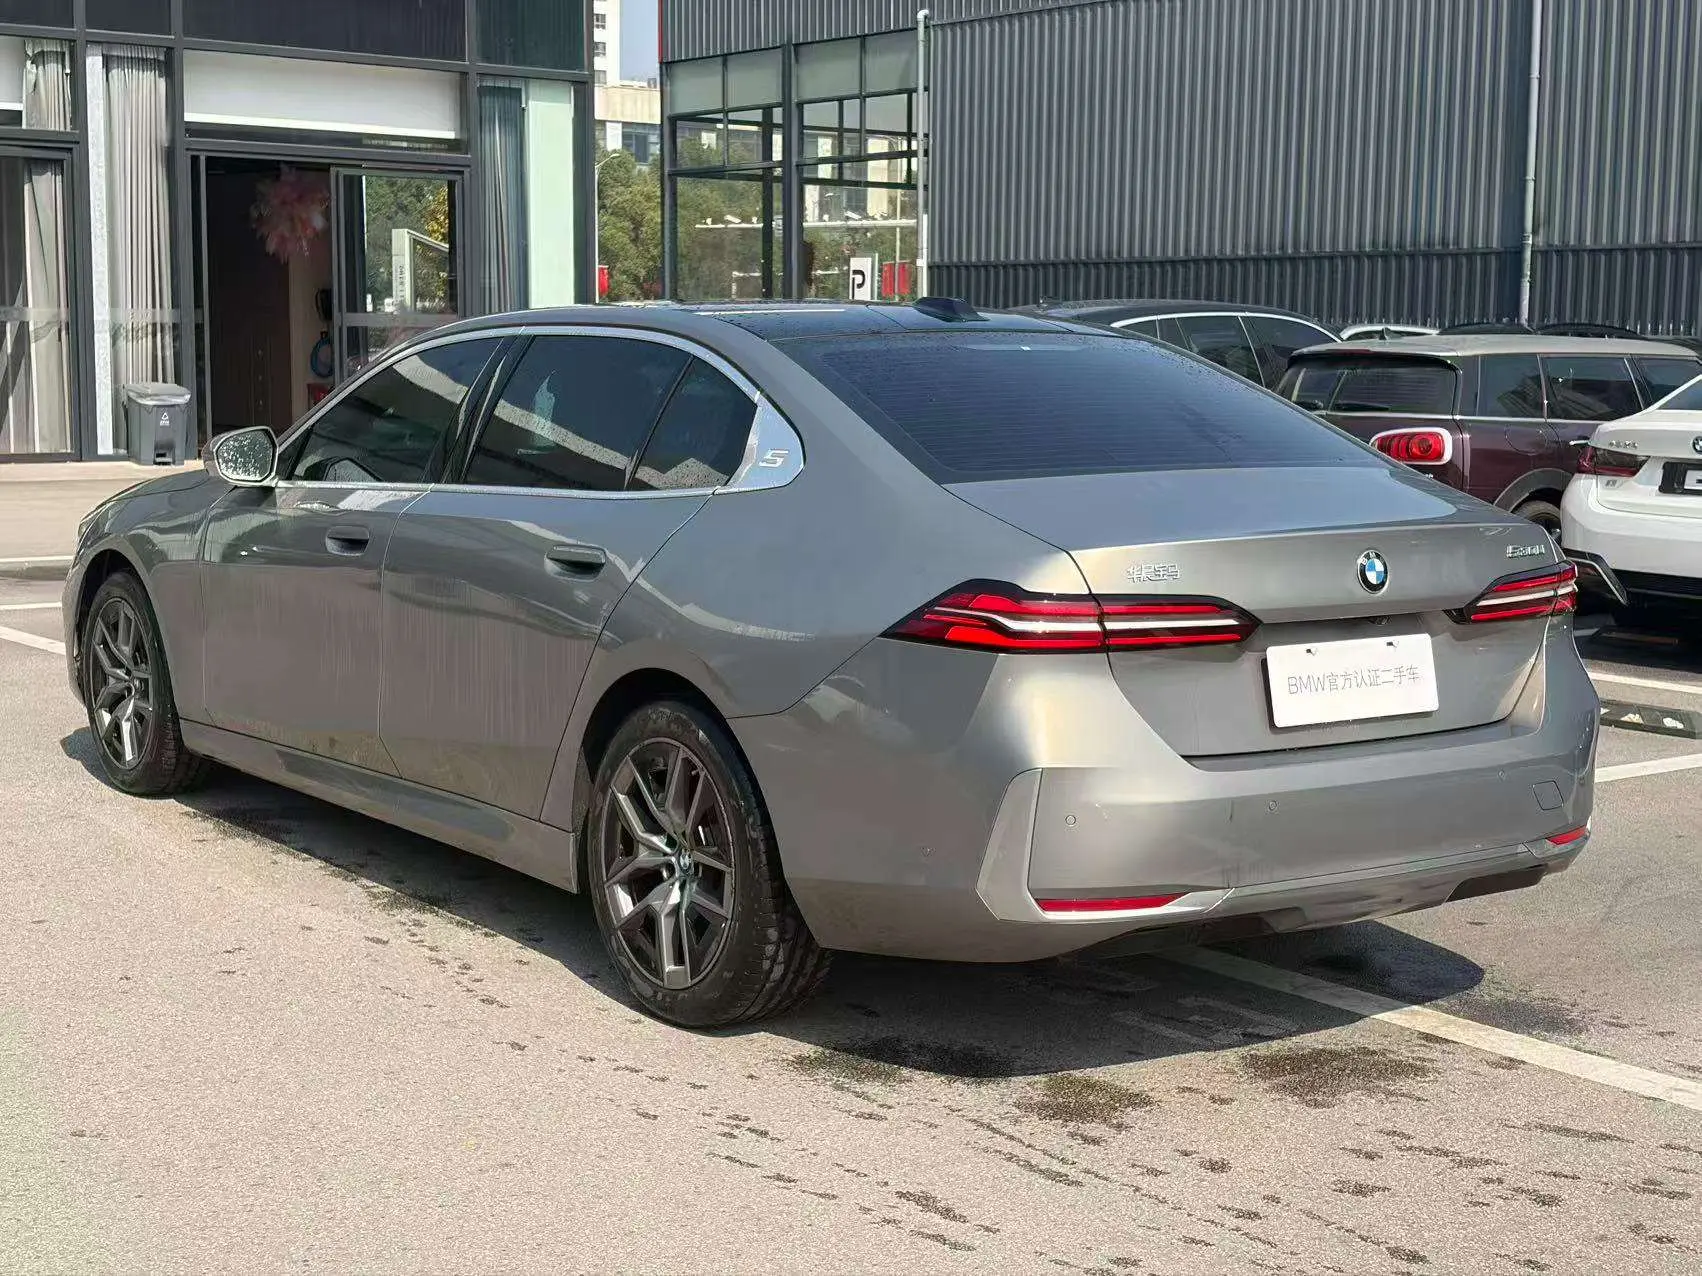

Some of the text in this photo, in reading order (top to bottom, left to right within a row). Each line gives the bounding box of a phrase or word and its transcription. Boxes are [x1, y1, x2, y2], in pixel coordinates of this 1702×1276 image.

[851, 269, 866, 300] P
[758, 449, 789, 468] 5
[1127, 563, 1180, 583] 华晨宝马
[1287, 663, 1421, 695] BMW官方认证二手车
